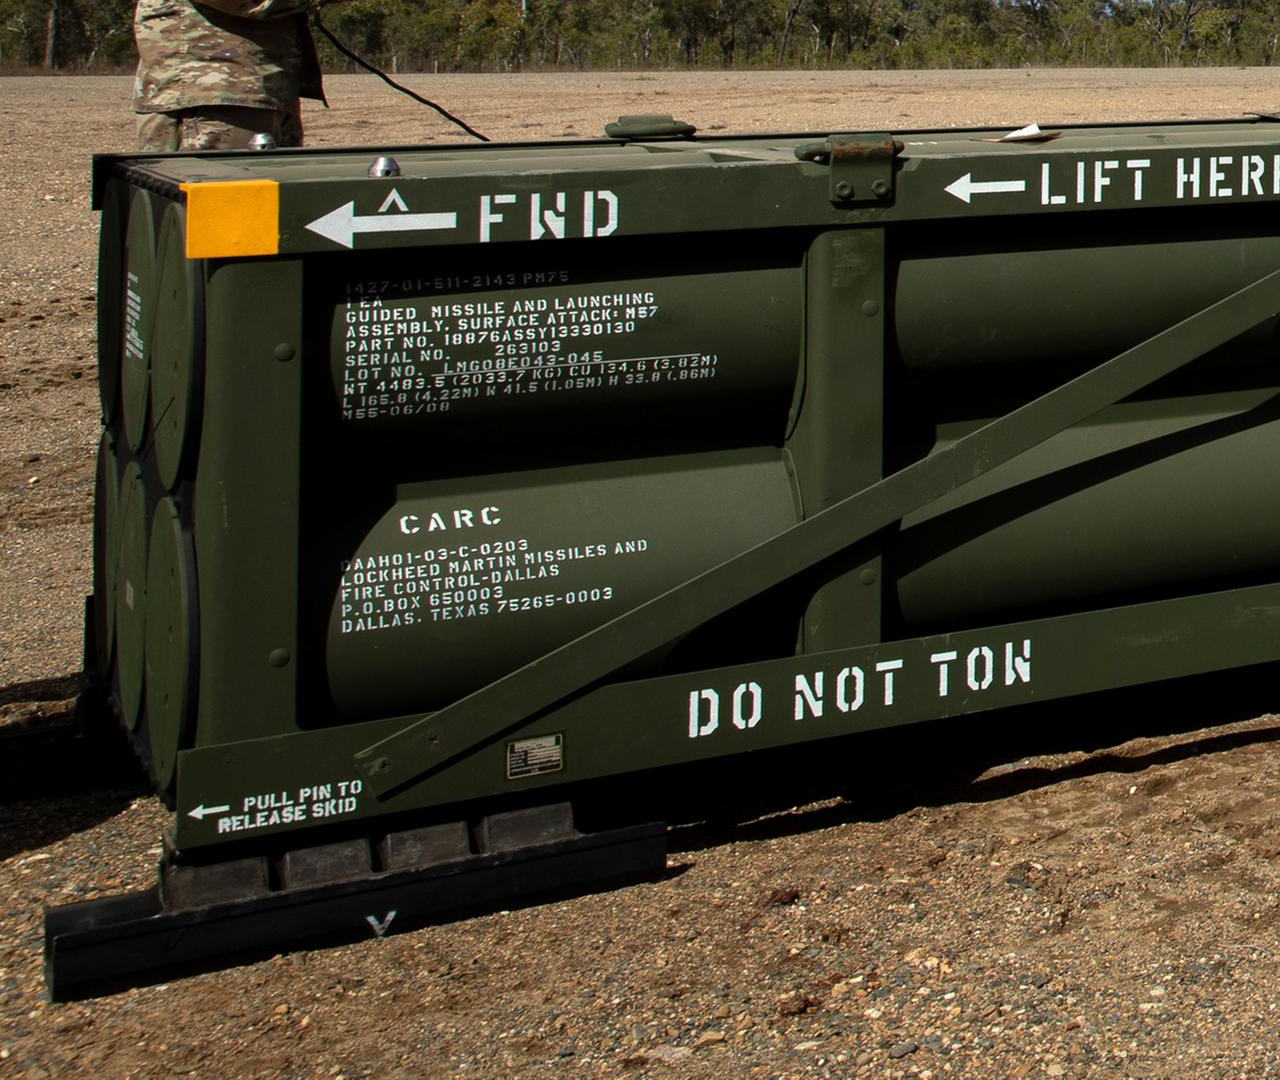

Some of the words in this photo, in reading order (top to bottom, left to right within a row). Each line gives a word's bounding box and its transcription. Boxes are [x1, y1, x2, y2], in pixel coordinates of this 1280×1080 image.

[1041, 158, 1150, 205] LIFT
[480, 190, 618, 243] FWD
[346, 307, 417, 323] GUIDED
[431, 301, 505, 319] MISSILE
[513, 299, 548, 313] AND
[555, 292, 655, 310] LAUNCHING
[458, 313, 539, 331] SURFACE
[547, 309, 618, 325] ATTACK:
[625, 306, 659, 319] M57
[345, 337, 395, 352] PART
[403, 335, 435, 349] NO.
[444, 321, 636, 346] 18876ASSY13330130
[345, 351, 412, 367] SERIAL
[420, 348, 451, 362] NO.
[495, 341, 561, 356] 263103
[343, 395, 352, 408] L
[361, 393, 407, 407] 165.8
[415, 387, 479, 403] (4.22M)
[504, 381, 538, 394] 41.5
[544, 376, 602, 391] (1.05M)
[609, 375, 619, 386] H
[625, 372, 660, 385] 33.8
[667, 368, 716, 382] (.86M)
[345, 367, 382, 382] LOT
[391, 365, 423, 378] NO.
[376, 376, 445, 392] 4483.5
[453, 370, 526, 386] (2033.7
[533, 367, 562, 380] KG)
[569, 364, 591, 377] CU
[600, 361, 646, 375] 134.6
[654, 354, 718, 370] (3.82M)
[400, 506, 501, 534] CARC
[341, 539, 529, 571] DAAH01-03-C-0203
[341, 563, 440, 586] LOCKHEED
[449, 555, 516, 574] MARTIN
[525, 544, 607, 565] MISSILES
[614, 539, 647, 555] AND
[341, 585, 385, 602] FIRE
[393, 564, 560, 595] CONTROL-DALLAS
[430, 586, 504, 606] 650003
[430, 602, 489, 621] TEXAS
[497, 587, 613, 613] 75265-0003
[688, 682, 762, 738] DO
[794, 659, 904, 721] NOT
[930, 639, 1031, 697] TOW
[243, 791, 294, 812] PULL
[299, 783, 332, 804] PIN
[337, 779, 363, 796] TO
[218, 804, 307, 834] RELEASE
[312, 796, 357, 818] SKID
